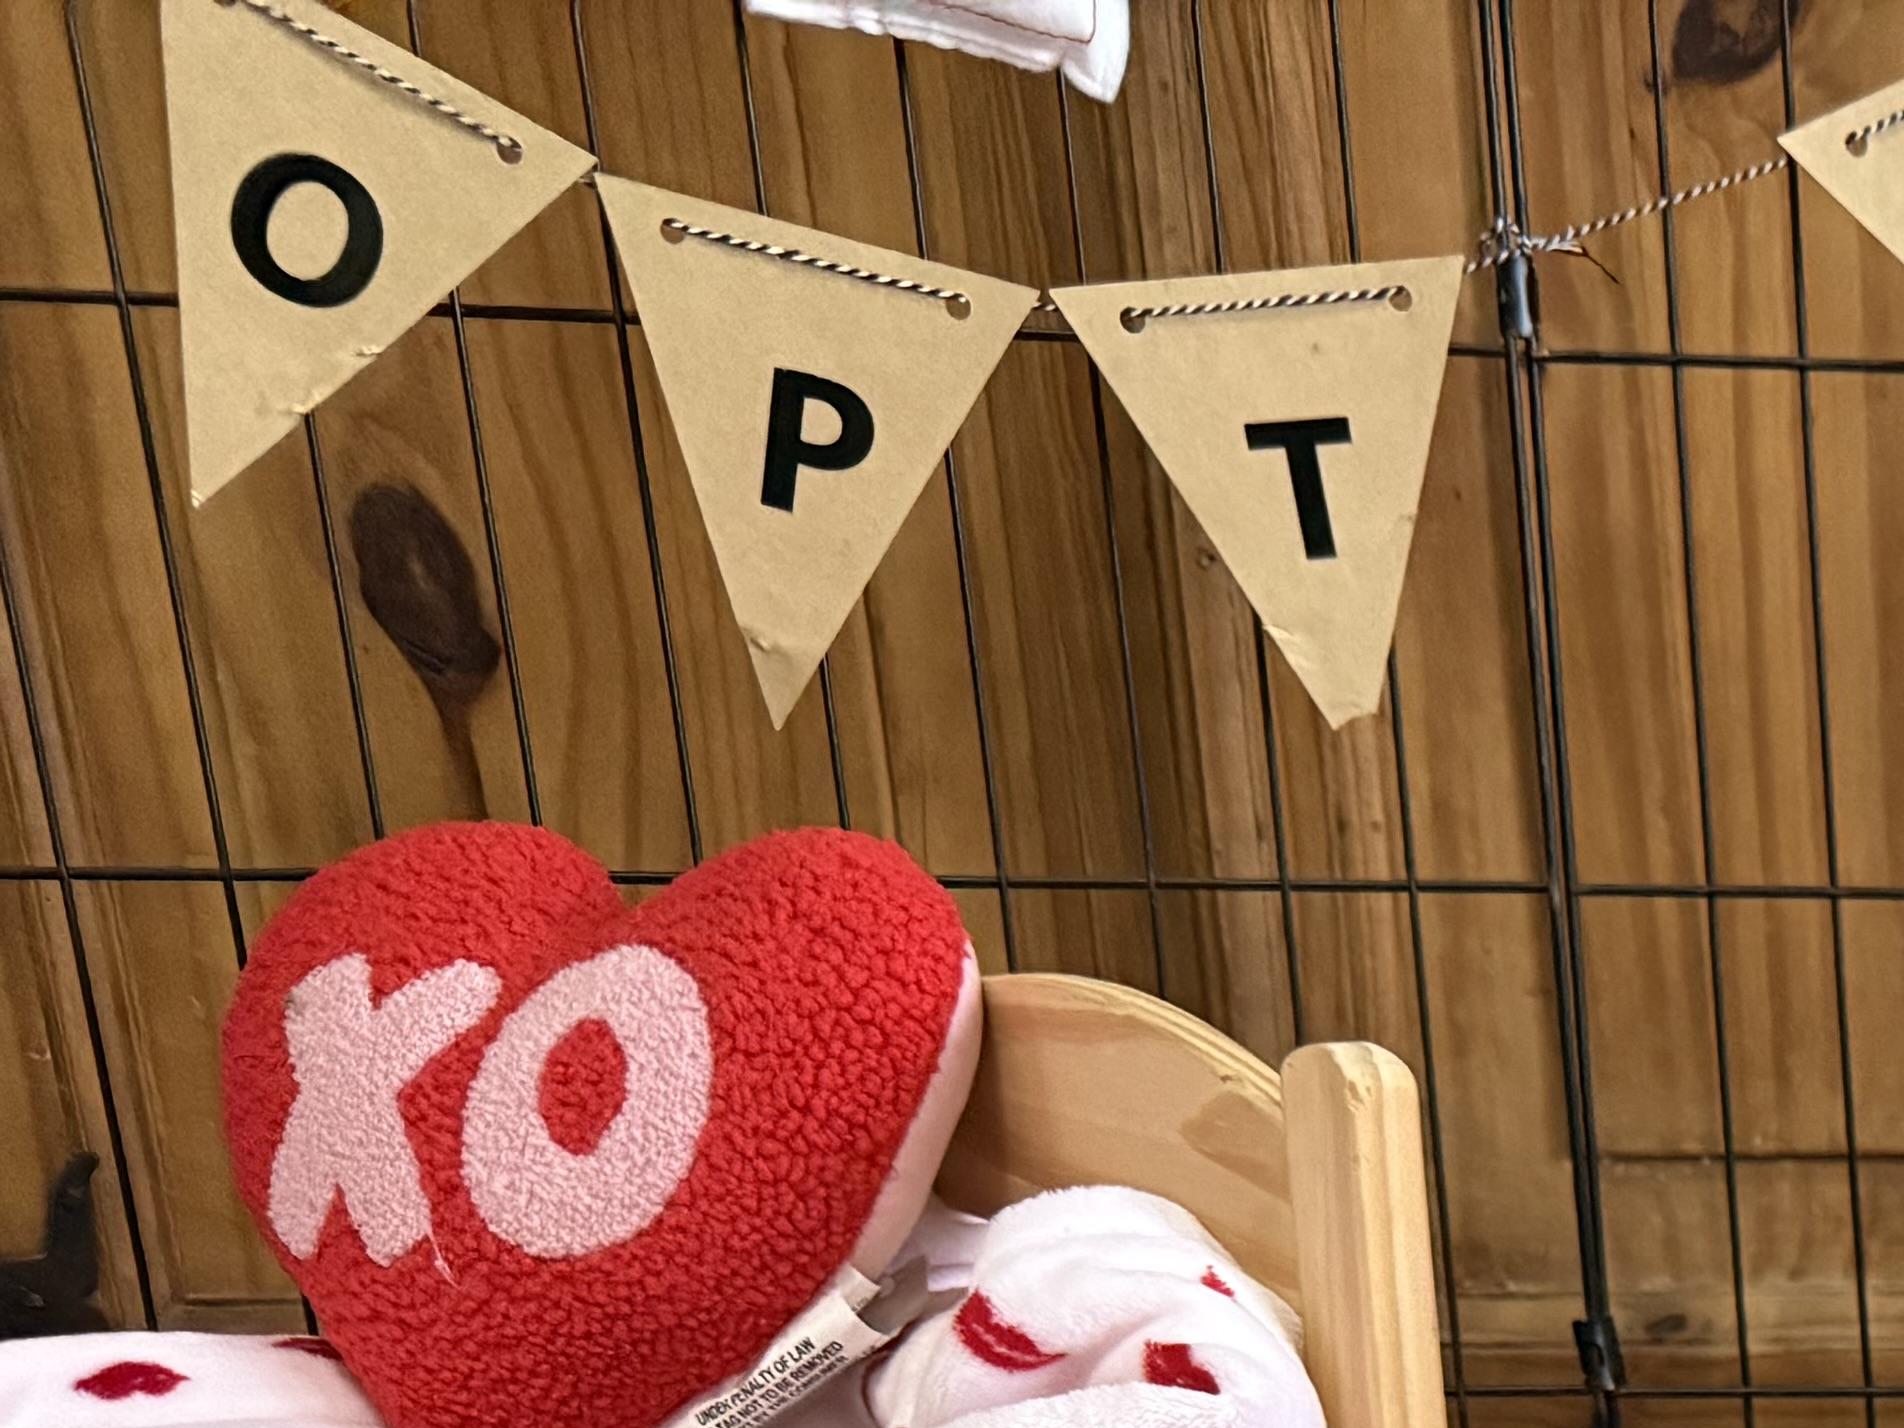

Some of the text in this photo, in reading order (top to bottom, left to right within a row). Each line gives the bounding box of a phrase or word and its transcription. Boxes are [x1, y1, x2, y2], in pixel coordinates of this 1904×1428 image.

[266, 944, 716, 1267] XO
[730, 1367, 776, 1406] PENALTY
[773, 1356, 789, 1374] OF
[787, 1336, 816, 1363] LAW
[739, 1398, 763, 1420] NOT
[759, 1386, 778, 1405] TO
[775, 1375, 793, 1395] BE
[792, 1339, 844, 1382] REMOVED
